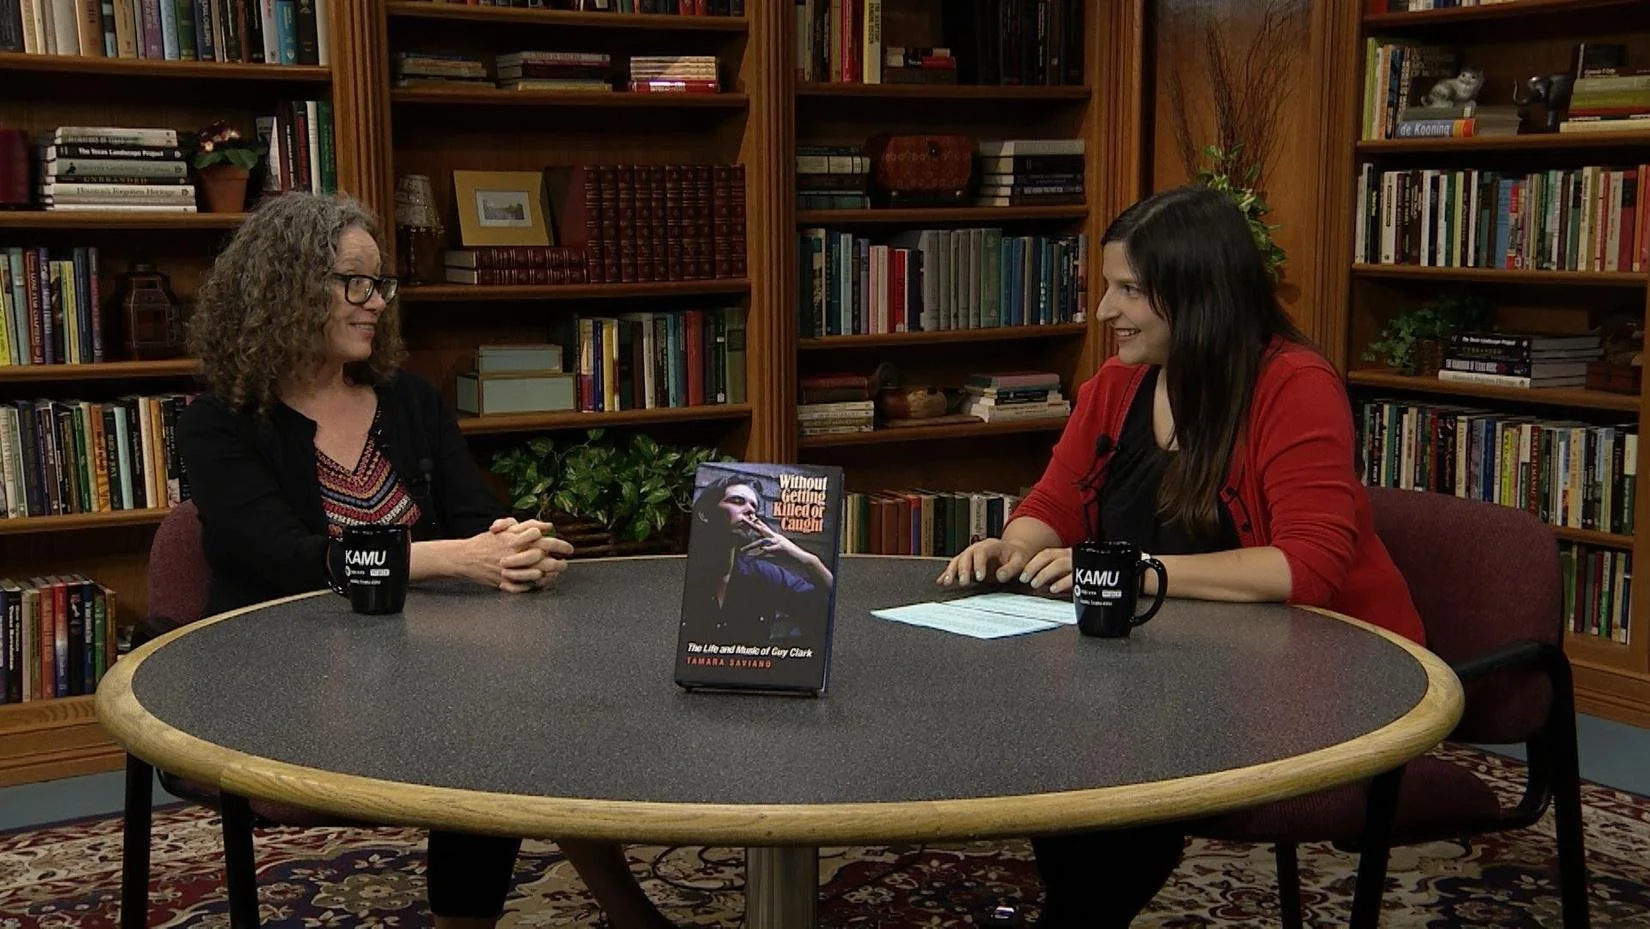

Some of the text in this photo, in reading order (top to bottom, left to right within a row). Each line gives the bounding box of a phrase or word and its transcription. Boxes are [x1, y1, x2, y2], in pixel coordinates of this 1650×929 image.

[1400, 122, 1450, 136] de Kooning
[79, 147, 90, 155] The
[91, 147, 108, 155] Texas
[779, 474, 828, 490] Without
[781, 489, 826, 506] Getting
[773, 501, 825, 518] Killed or
[781, 517, 824, 533] Caught
[345, 550, 387, 566] KAMU
[1075, 567, 1120, 587] KAMU
[687, 642, 813, 659] The Life and Music of Guy Clark
[687, 657, 772, 668] TAMARA SAVIANO
